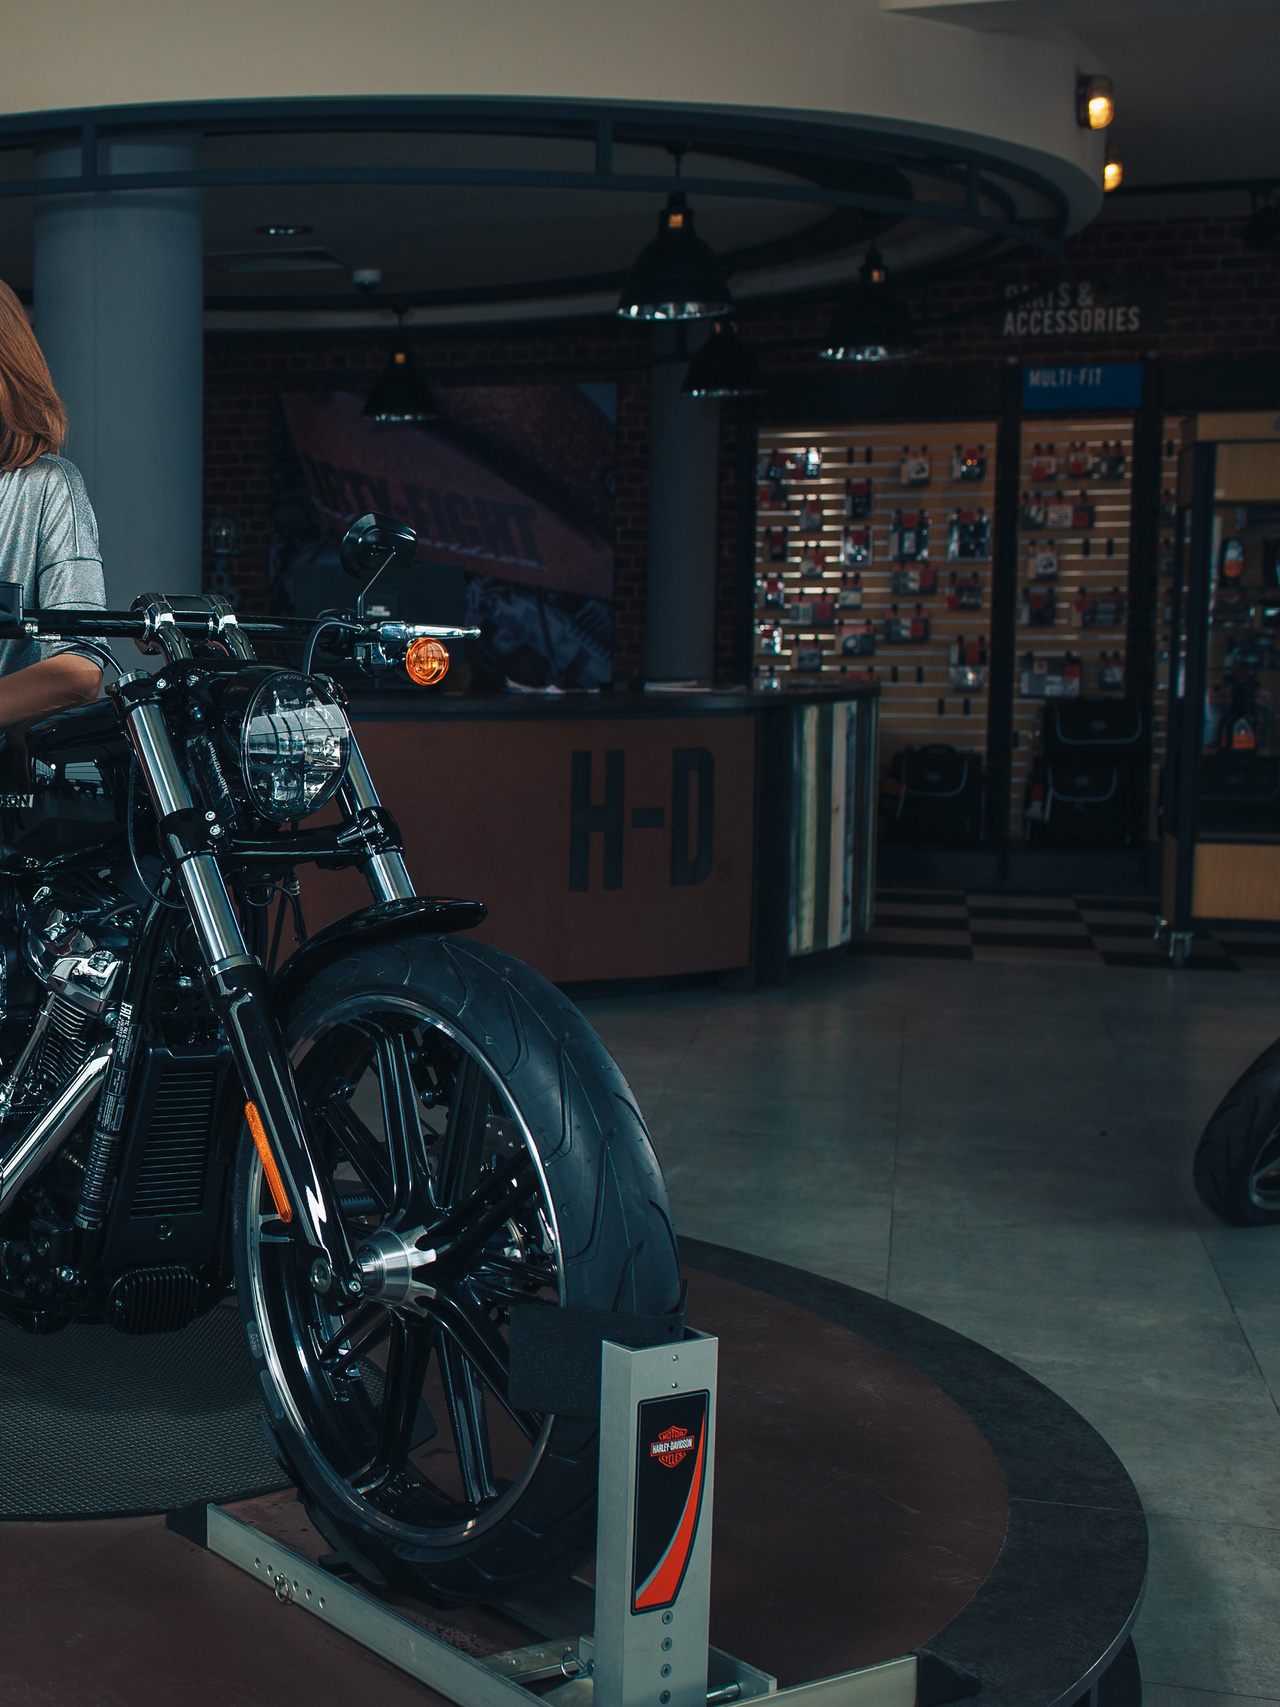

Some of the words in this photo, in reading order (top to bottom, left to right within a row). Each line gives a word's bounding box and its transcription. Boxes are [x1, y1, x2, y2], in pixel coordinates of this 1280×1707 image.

[1078, 281, 1095, 307] &
[1003, 306, 1140, 336] ACCESSORIES
[1028, 366, 1103, 388] MULTI-FIT
[652, 1438, 693, 1454] HARLEY-DAVIDSON
